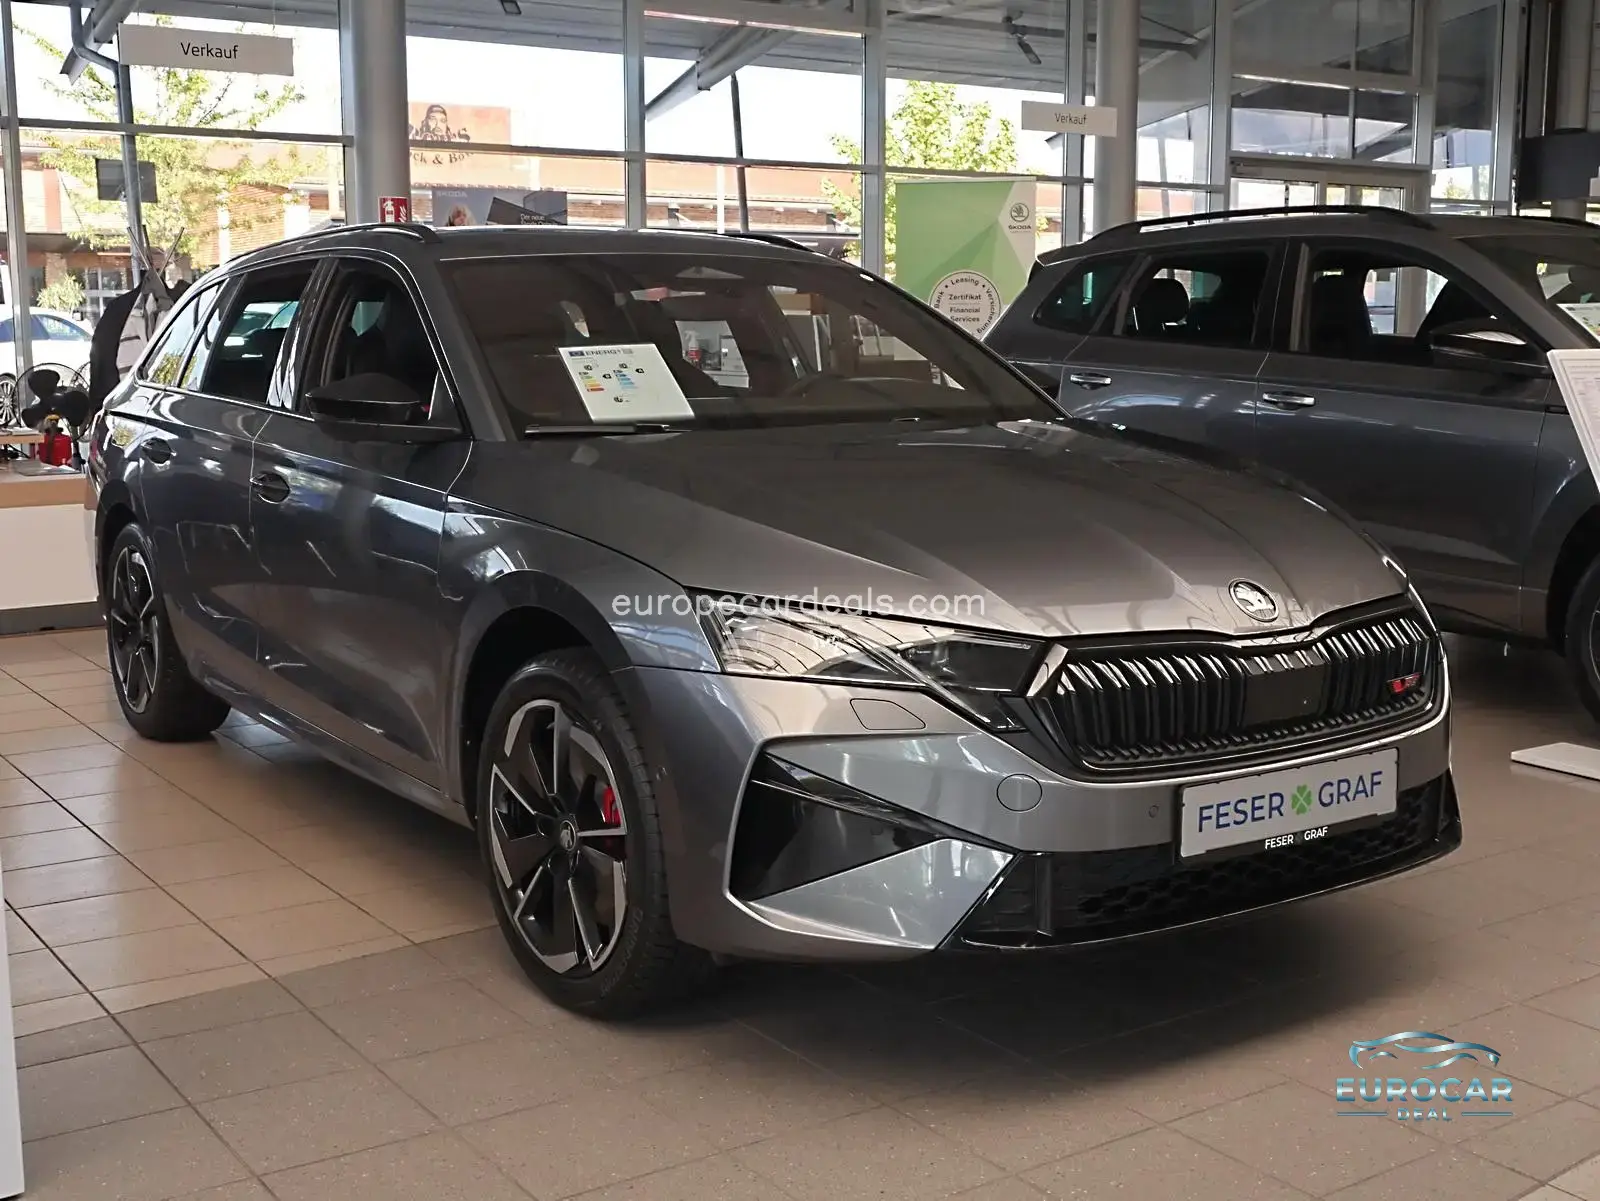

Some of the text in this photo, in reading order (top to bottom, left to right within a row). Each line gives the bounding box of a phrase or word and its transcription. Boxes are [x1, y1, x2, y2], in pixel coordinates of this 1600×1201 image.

[180, 42, 239, 59] Verkauf
[1054, 112, 1088, 125] Verkauf
[432, 155, 443, 165] &
[934, 291, 944, 309] Bank
[951, 276, 980, 286] Leasing
[1198, 770, 1383, 833] FESER GRAF
[1264, 826, 1329, 850] FESER GRAF
